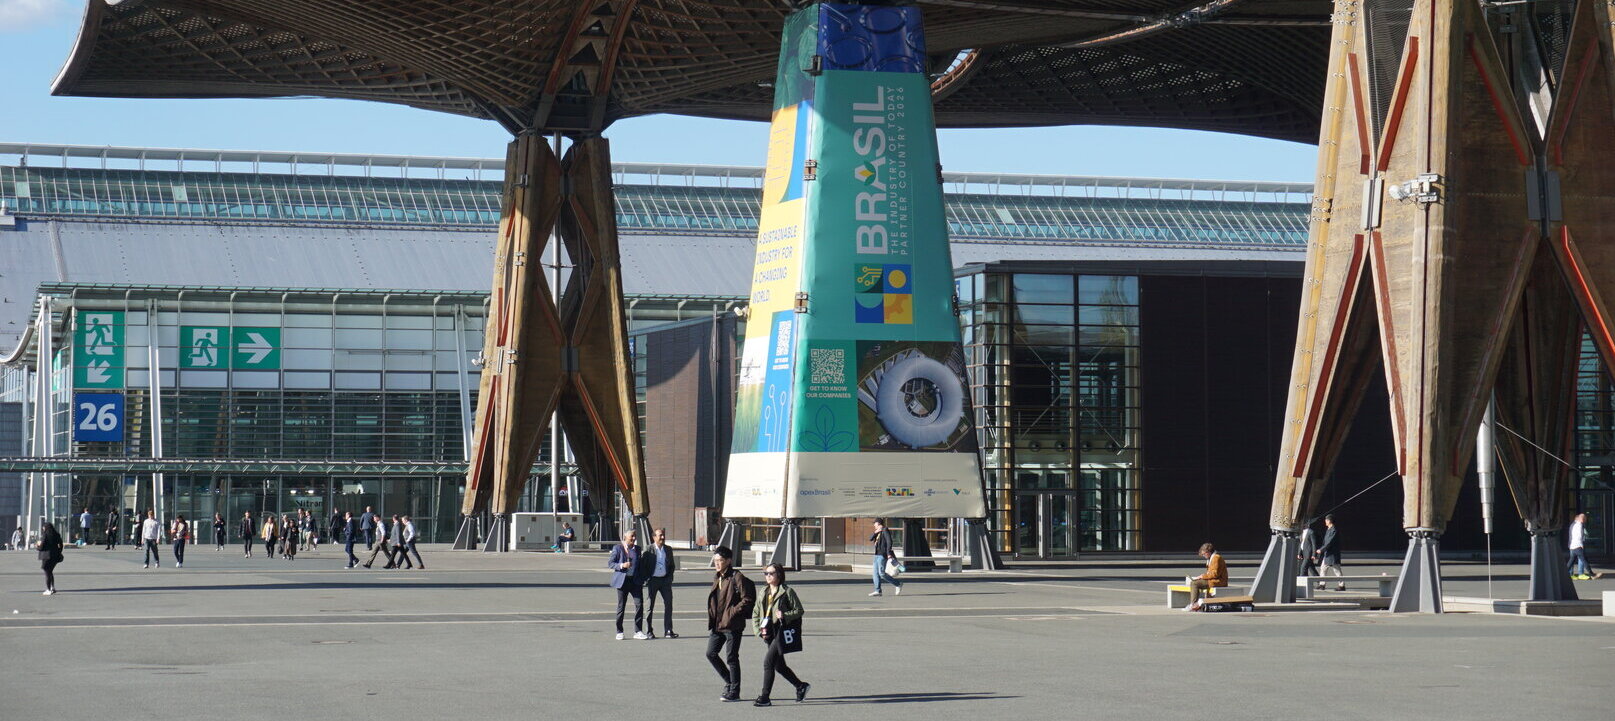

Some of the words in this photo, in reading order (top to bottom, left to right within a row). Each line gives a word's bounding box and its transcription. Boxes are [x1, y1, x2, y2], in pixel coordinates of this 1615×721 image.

[887, 87, 896, 129] TODAY
[896, 87, 904, 118] 2026
[888, 136, 896, 152] OF
[898, 126, 906, 189] COUNTRY
[853, 85, 888, 254] BRASIL
[889, 159, 898, 224] INDUSTRY
[890, 231, 899, 254] THE
[900, 197, 908, 255] PARTNER
[782, 246, 793, 260] FOR
[80, 402, 118, 432] 26
